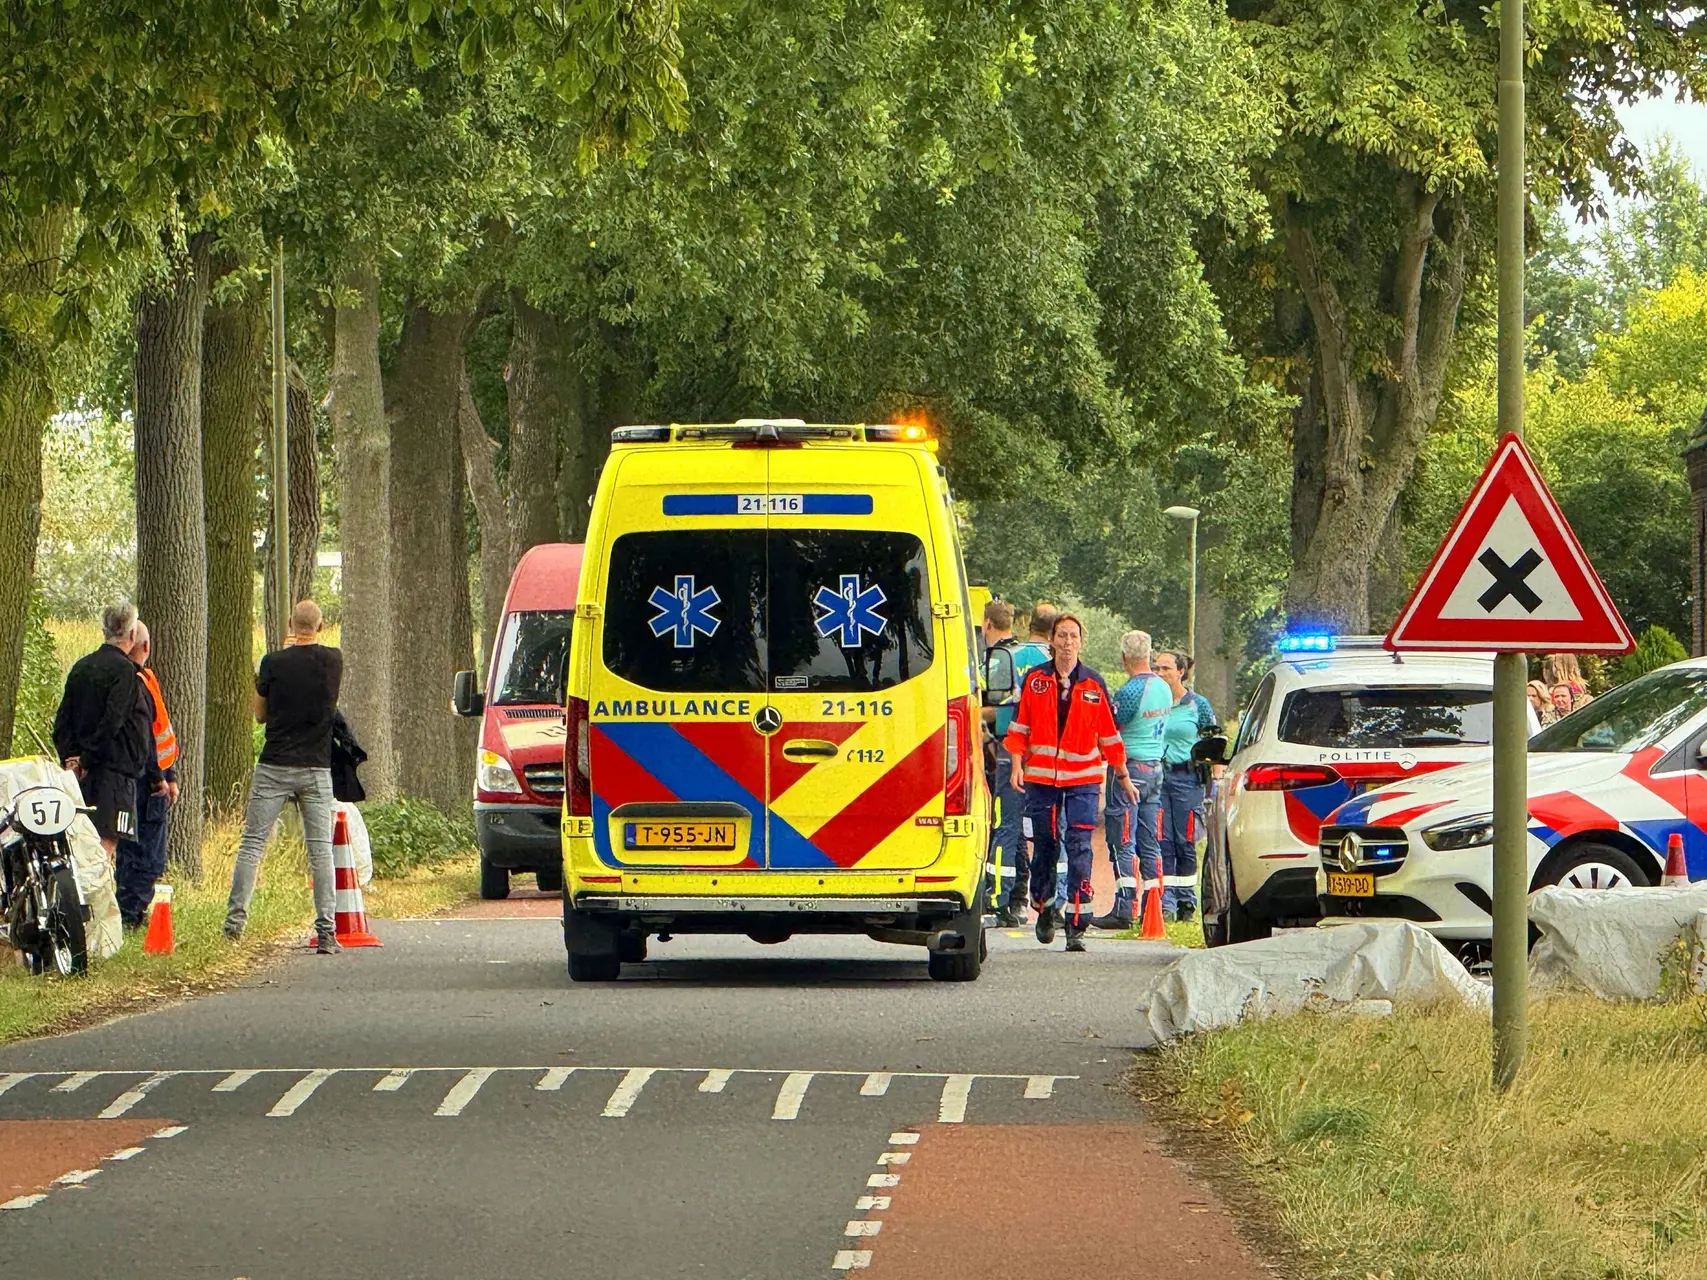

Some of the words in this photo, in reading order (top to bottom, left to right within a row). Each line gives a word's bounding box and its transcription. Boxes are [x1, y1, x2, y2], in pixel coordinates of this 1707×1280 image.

[742, 497, 799, 511] 21-116
[593, 699, 750, 716] AMBULANCE
[822, 700, 893, 716] 21-116
[1319, 751, 1392, 762] POLITIE
[31, 800, 61, 826] 57
[643, 826, 726, 843] T-955-JN
